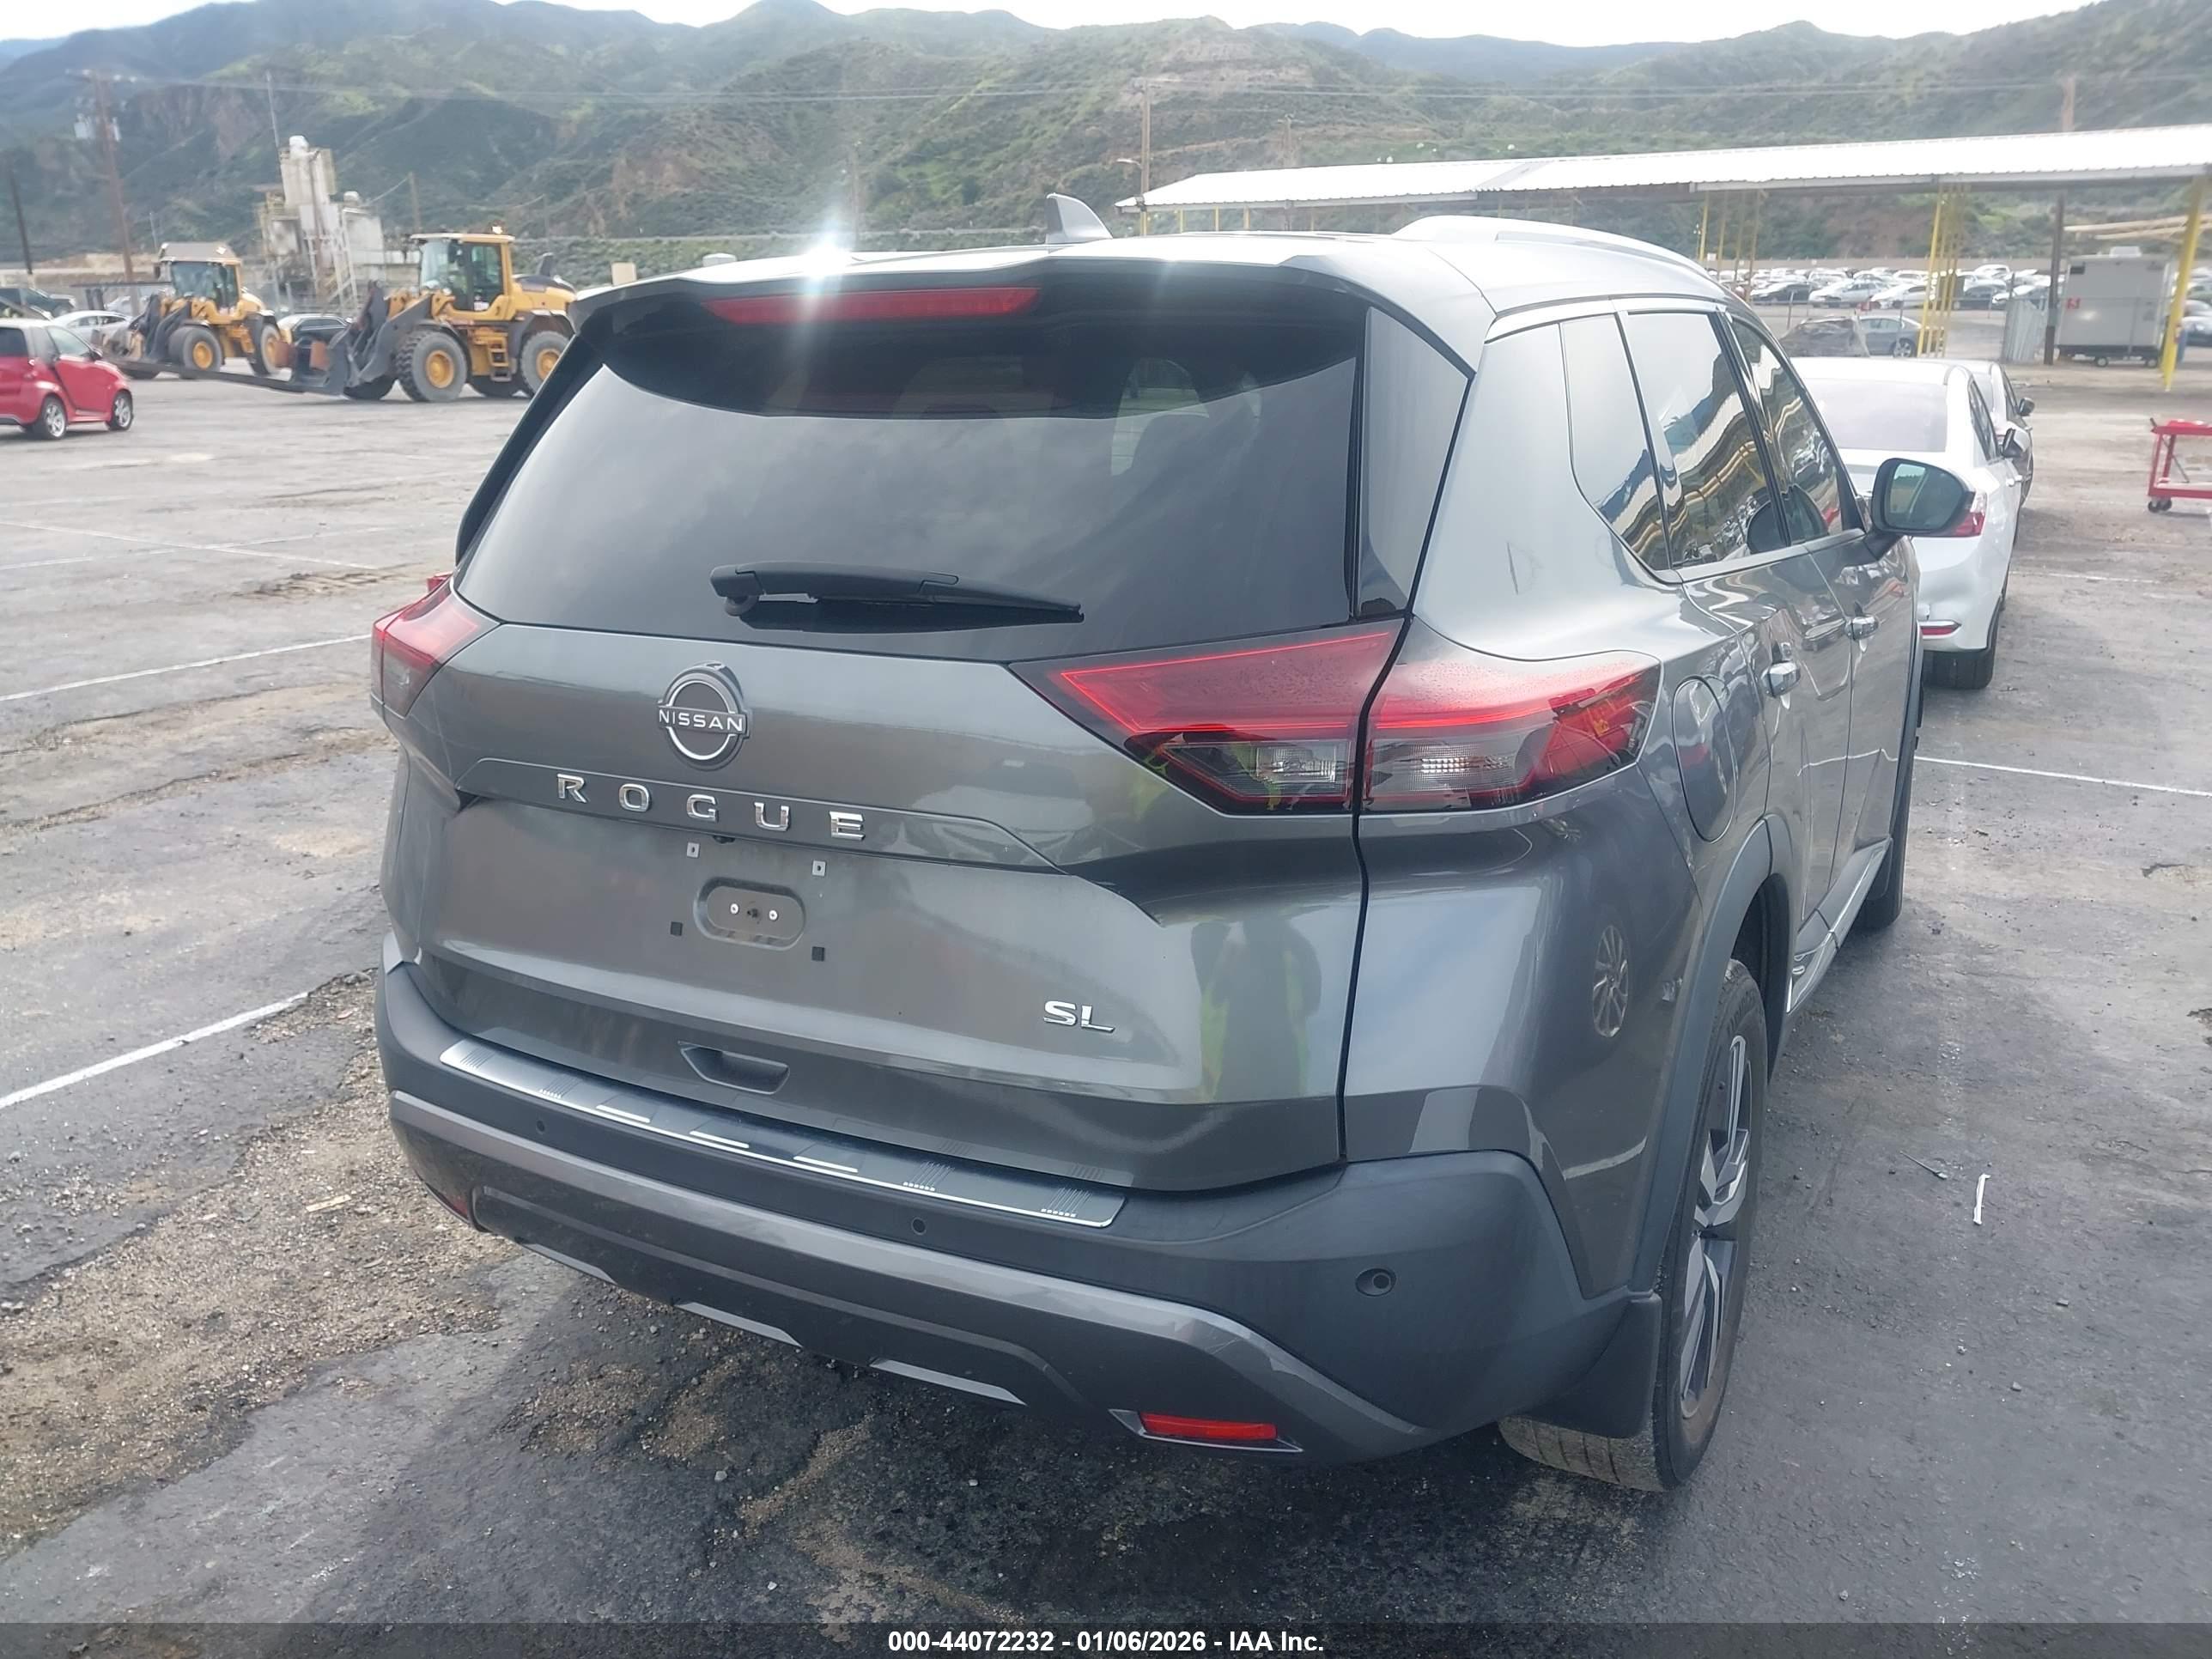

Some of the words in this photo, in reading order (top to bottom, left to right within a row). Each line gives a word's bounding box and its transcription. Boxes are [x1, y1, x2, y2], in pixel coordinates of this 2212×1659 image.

[659, 708, 744, 732] NISSAN
[556, 773, 866, 841] ROGUE
[1043, 1000, 1115, 1033] SL
